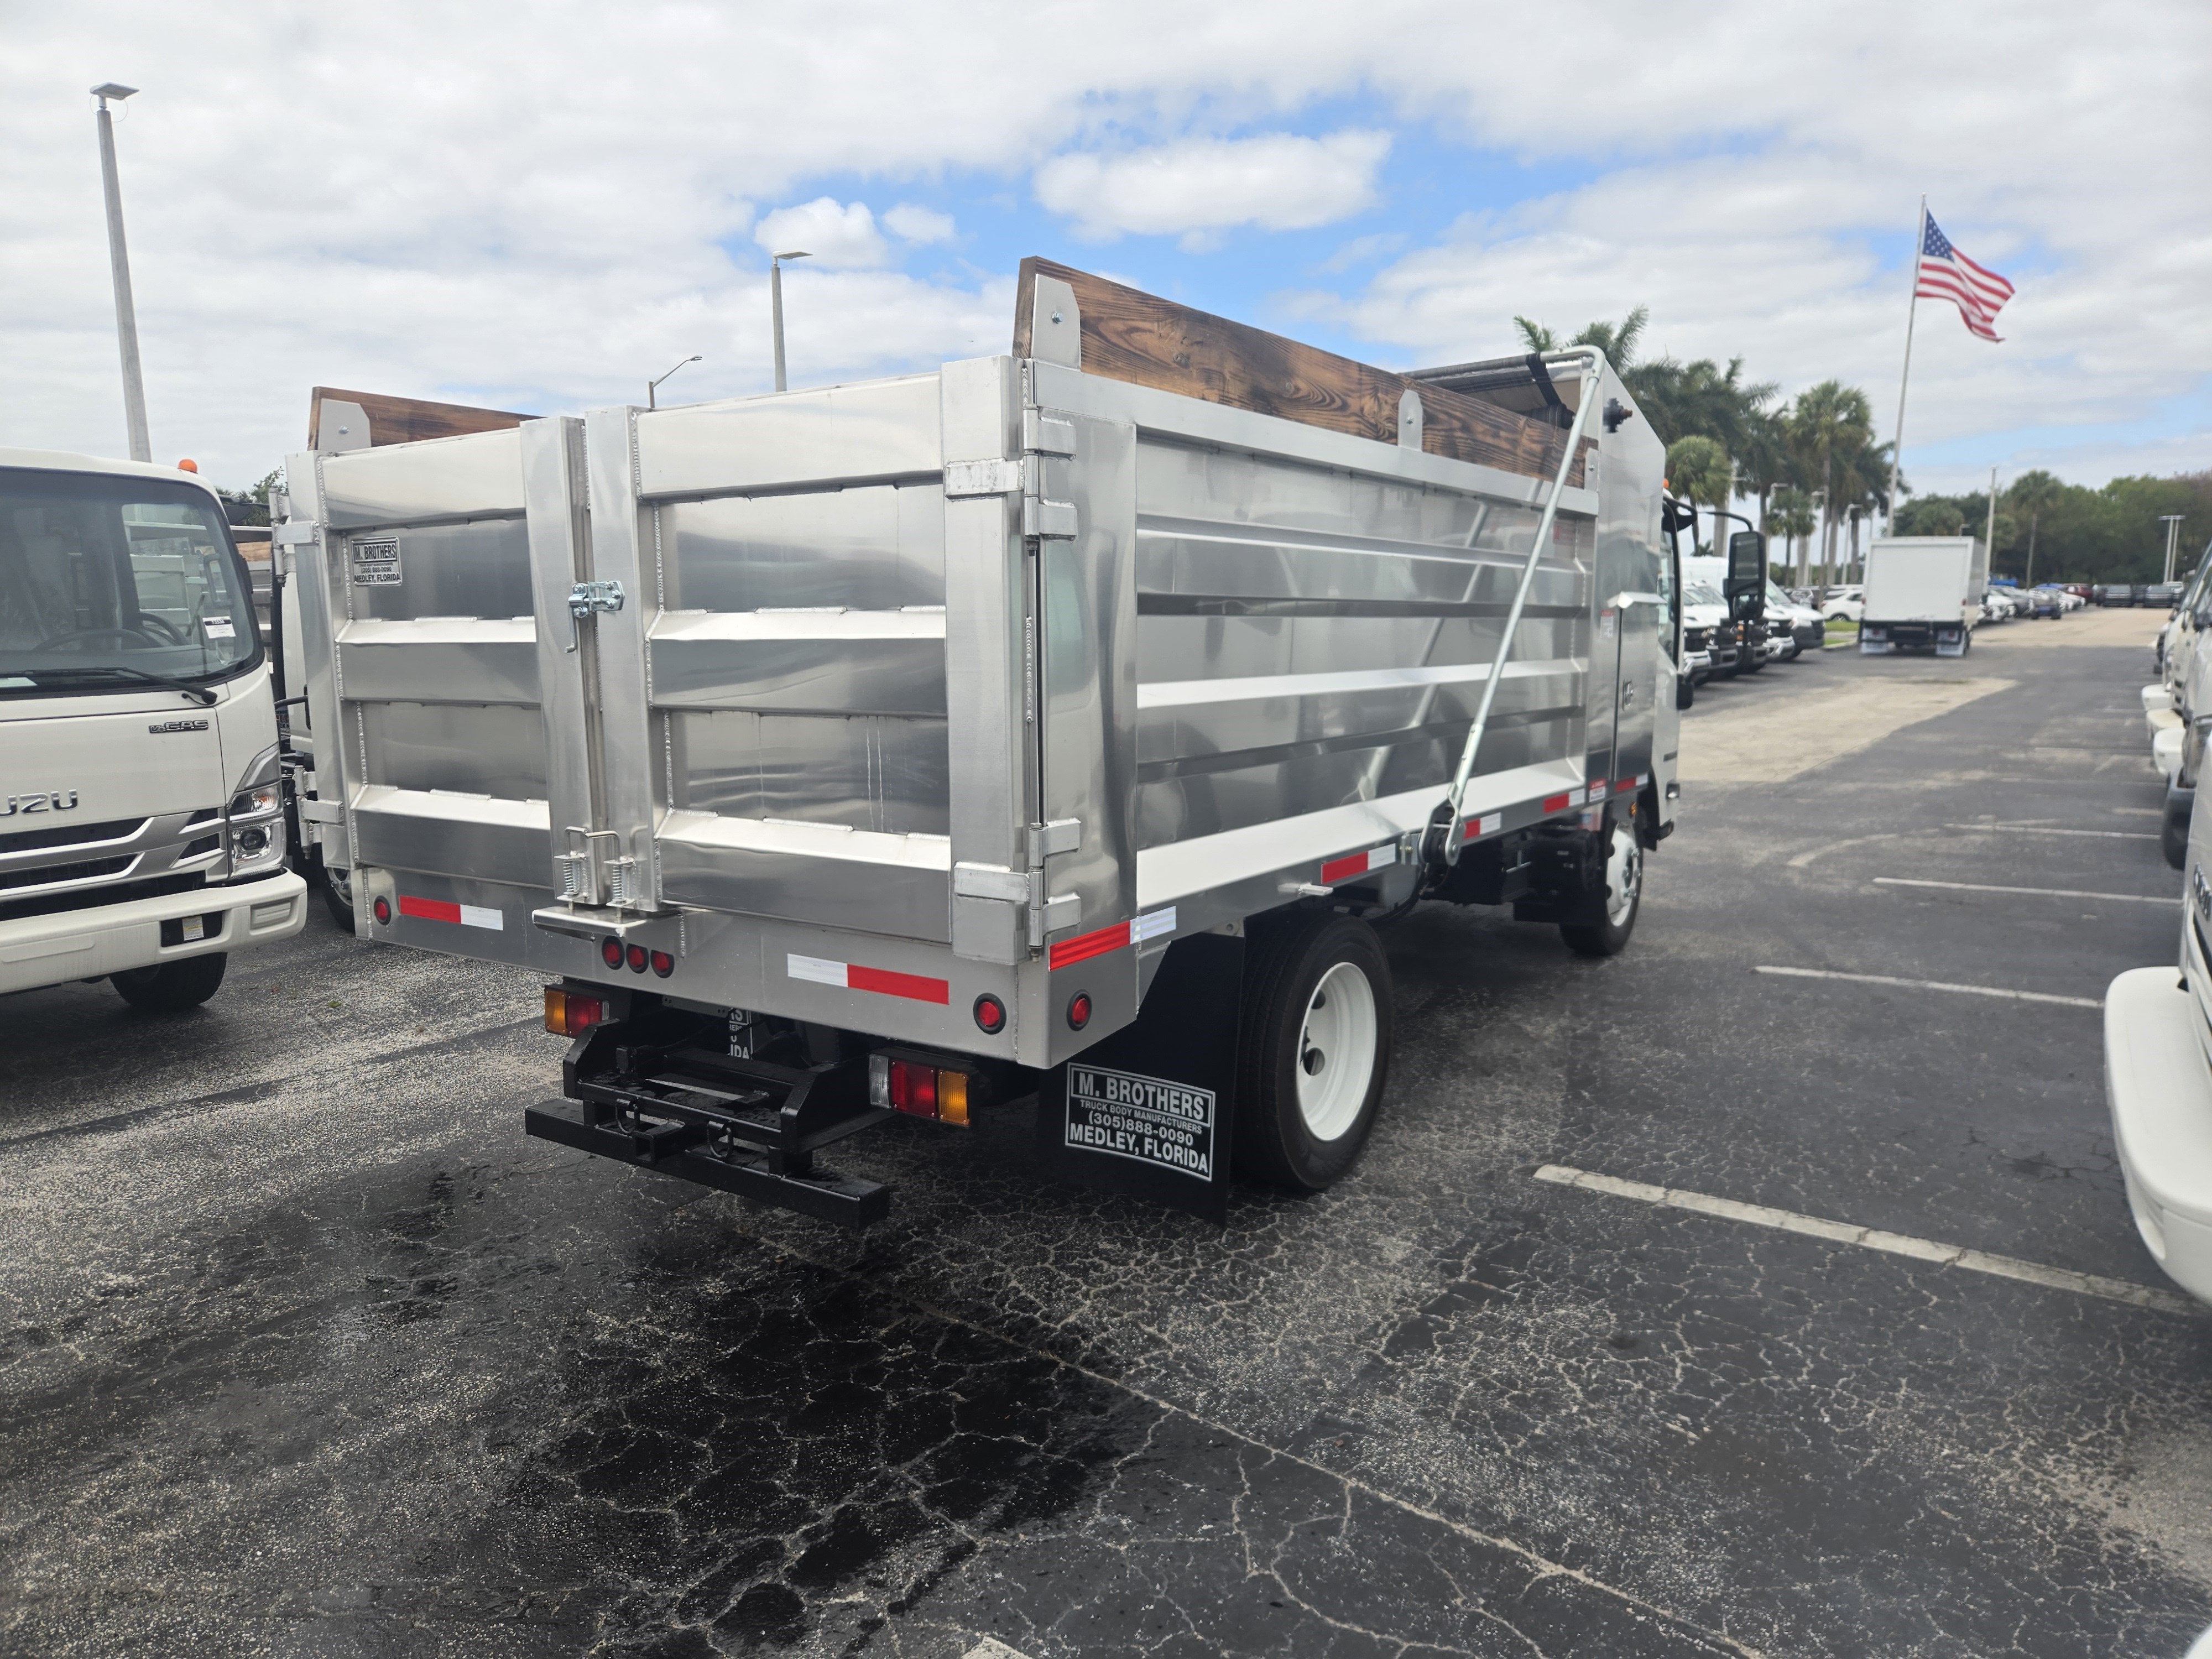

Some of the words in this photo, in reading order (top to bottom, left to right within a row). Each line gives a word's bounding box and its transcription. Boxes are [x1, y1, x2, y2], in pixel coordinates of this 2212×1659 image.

[354, 546, 363, 560] M.
[364, 544, 397, 559] BROTHERS
[354, 573, 376, 583] MEDLEY,
[377, 573, 400, 582] FLORIDA
[727, 1044, 749, 1060] IDA
[1078, 1072, 1099, 1097] M.
[1107, 1077, 1204, 1121] BROTHERS
[1080, 1099, 1108, 1112] TRUCK
[1110, 1105, 1131, 1118] BODY
[1134, 1109, 1202, 1134] MANUFACTURERS
[1088, 1110, 1193, 1146] (305)888-0090
[1070, 1123, 1139, 1155] MEDLEY,
[1144, 1136, 1209, 1173] FLORIDA
